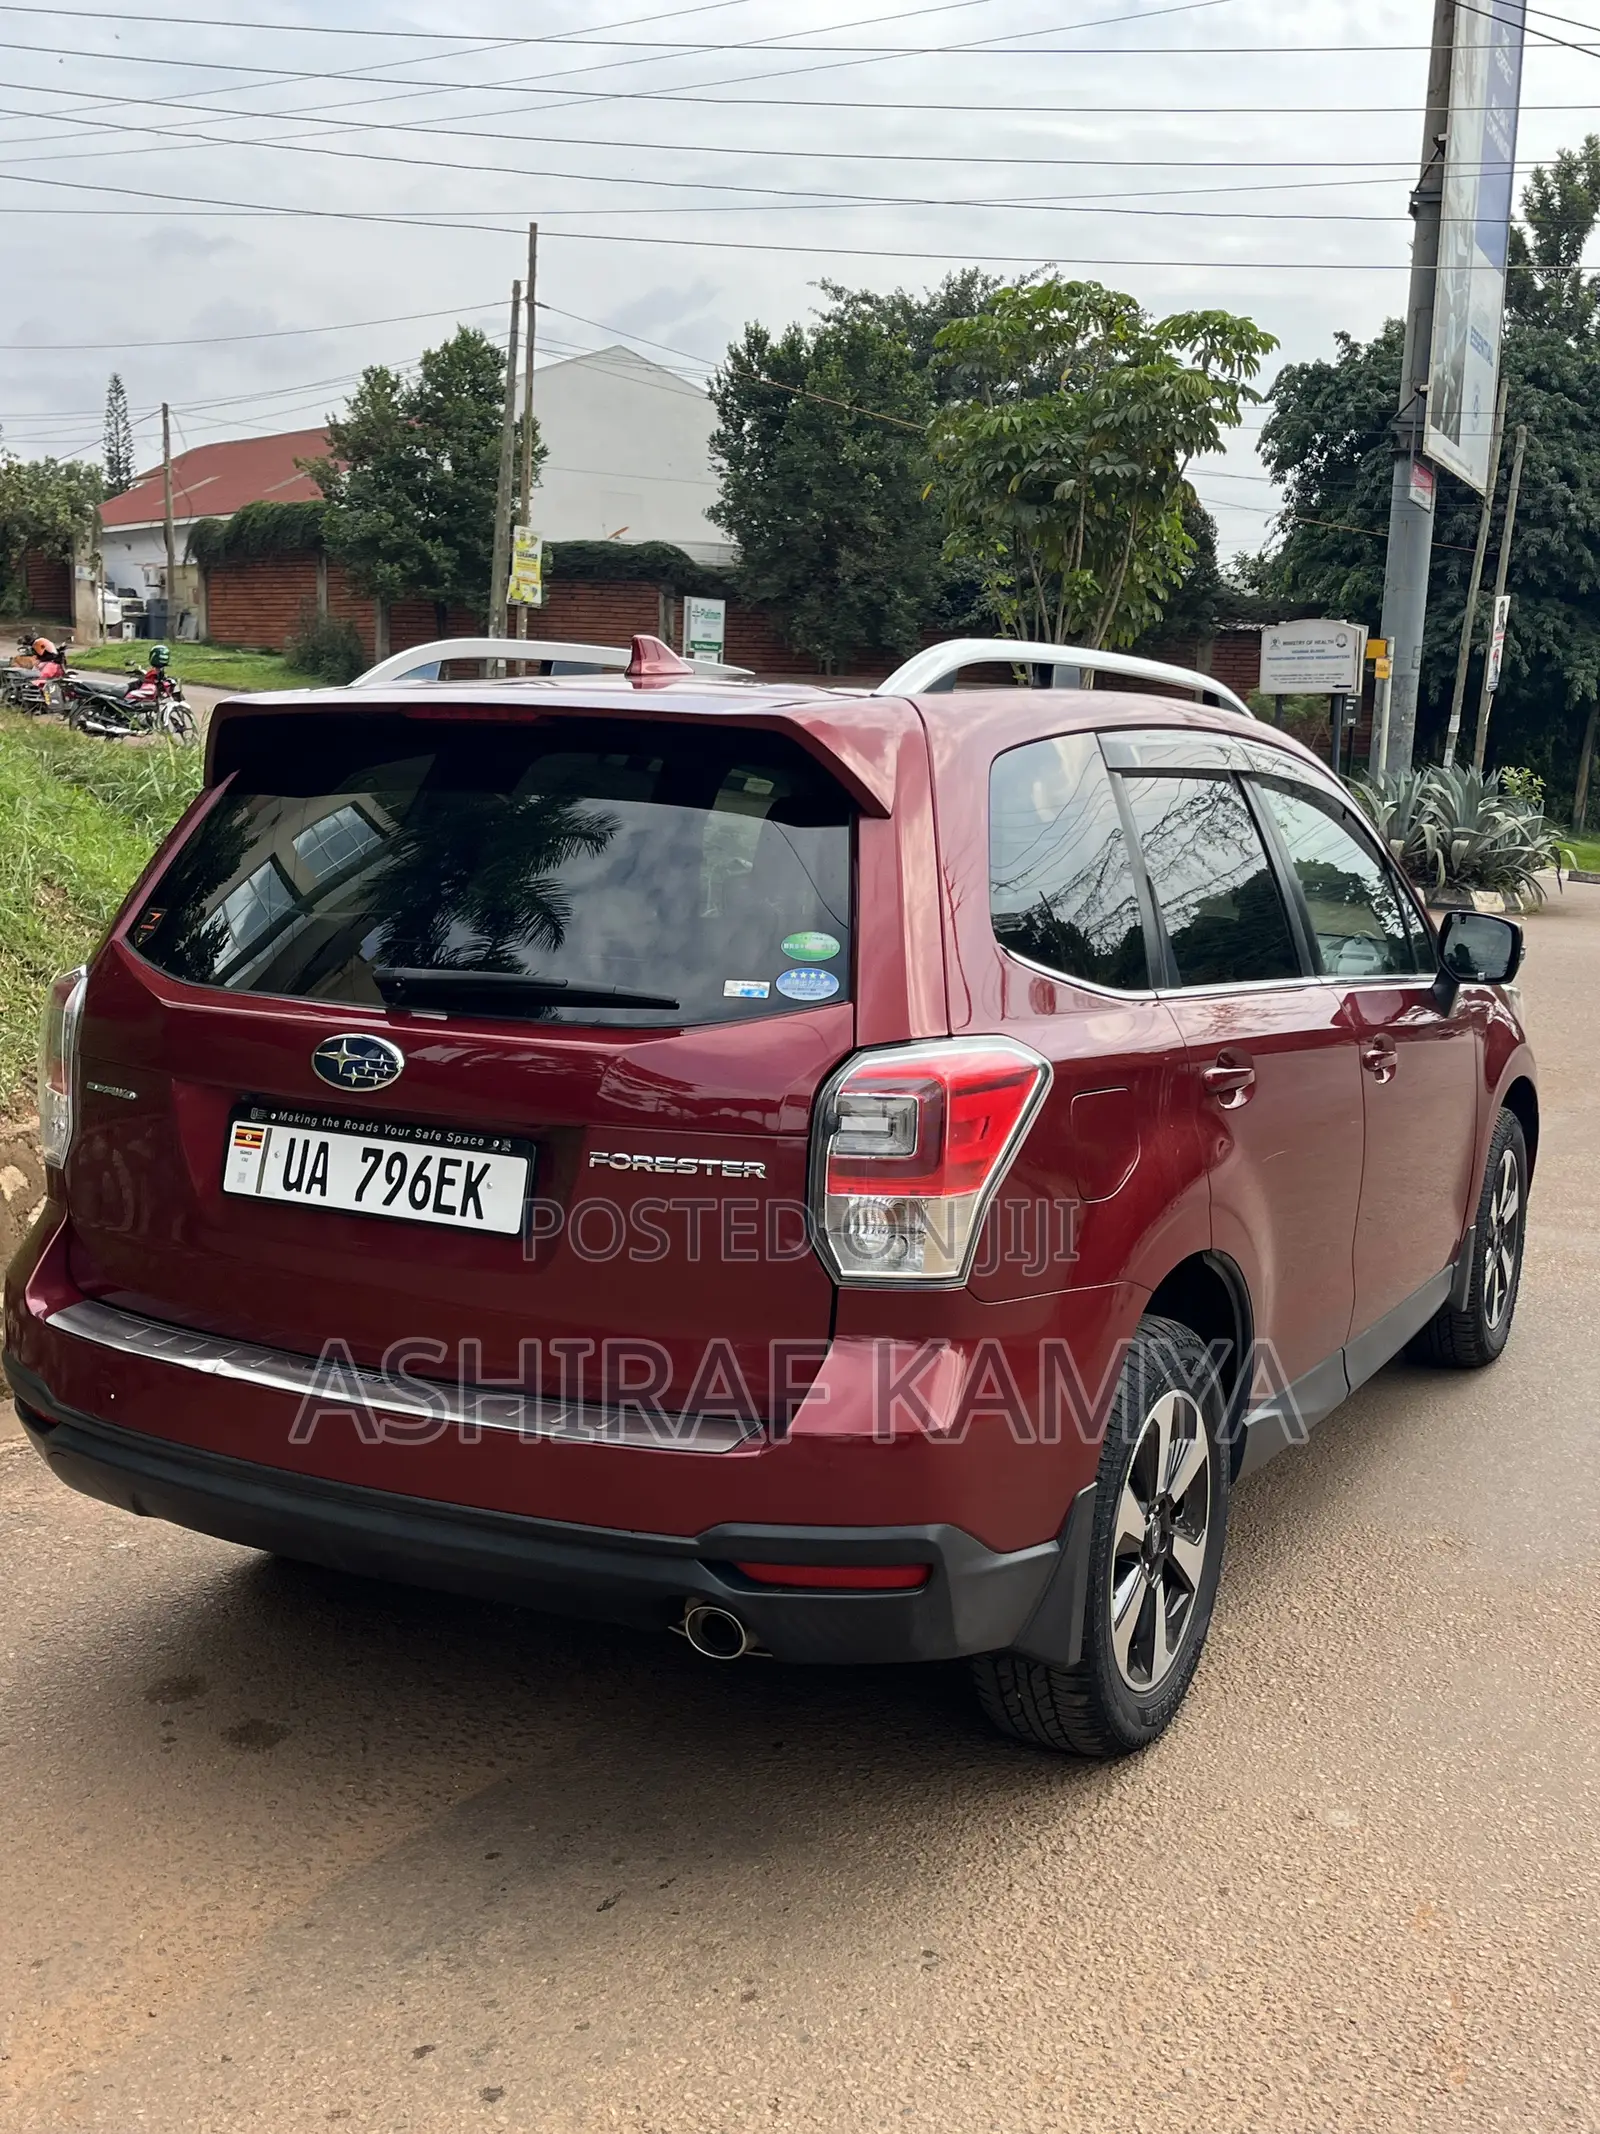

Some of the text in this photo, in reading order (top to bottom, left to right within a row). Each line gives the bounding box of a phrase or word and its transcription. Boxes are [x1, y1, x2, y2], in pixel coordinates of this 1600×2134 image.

[278, 1111, 317, 1127] Making
[322, 1116, 340, 1128] the
[344, 1119, 379, 1133] Roads
[384, 1124, 411, 1137] Your
[415, 1128, 442, 1141] Safe
[446, 1132, 485, 1146] Space
[282, 1137, 491, 1220] UA 796EK
[589, 1151, 767, 1179] FORESTER
